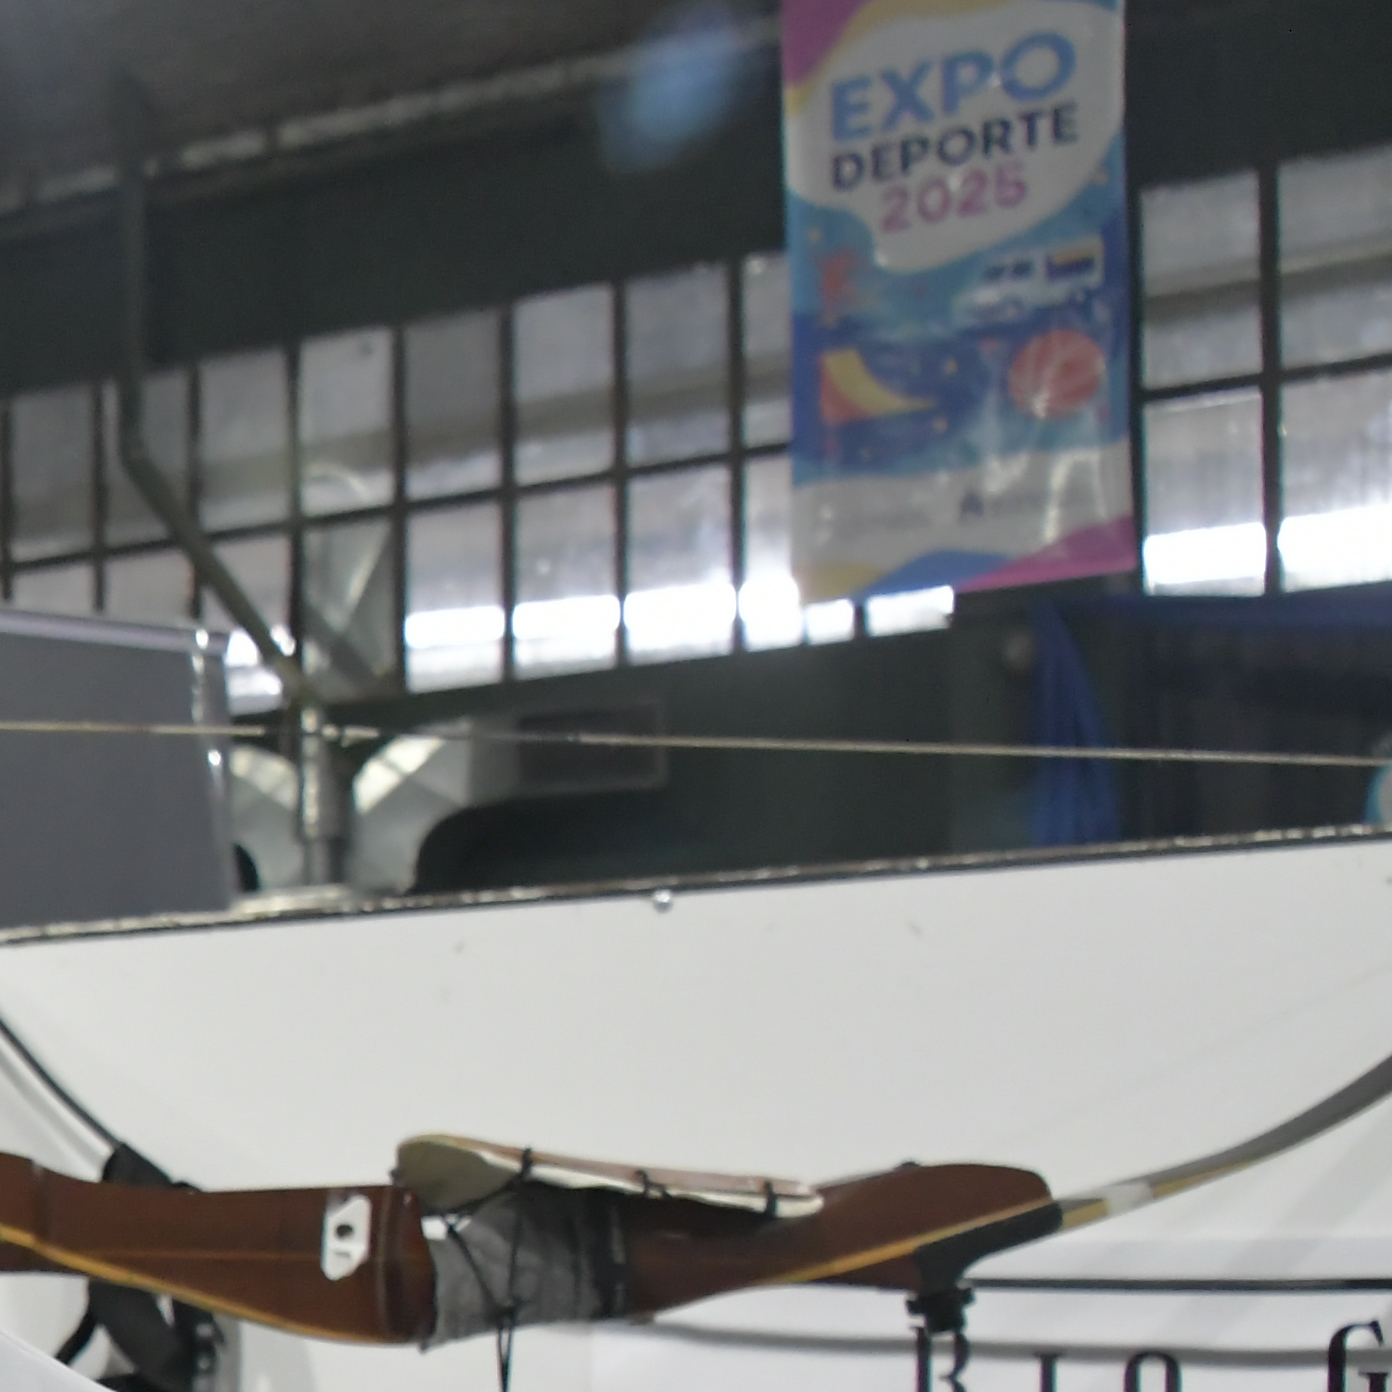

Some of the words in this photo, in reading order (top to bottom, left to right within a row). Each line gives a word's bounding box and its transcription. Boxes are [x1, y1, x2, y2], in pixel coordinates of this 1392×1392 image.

[830, 31, 1076, 143] EXPO
[831, 101, 1081, 192] DEPORTE
[880, 164, 1028, 233] 2025
